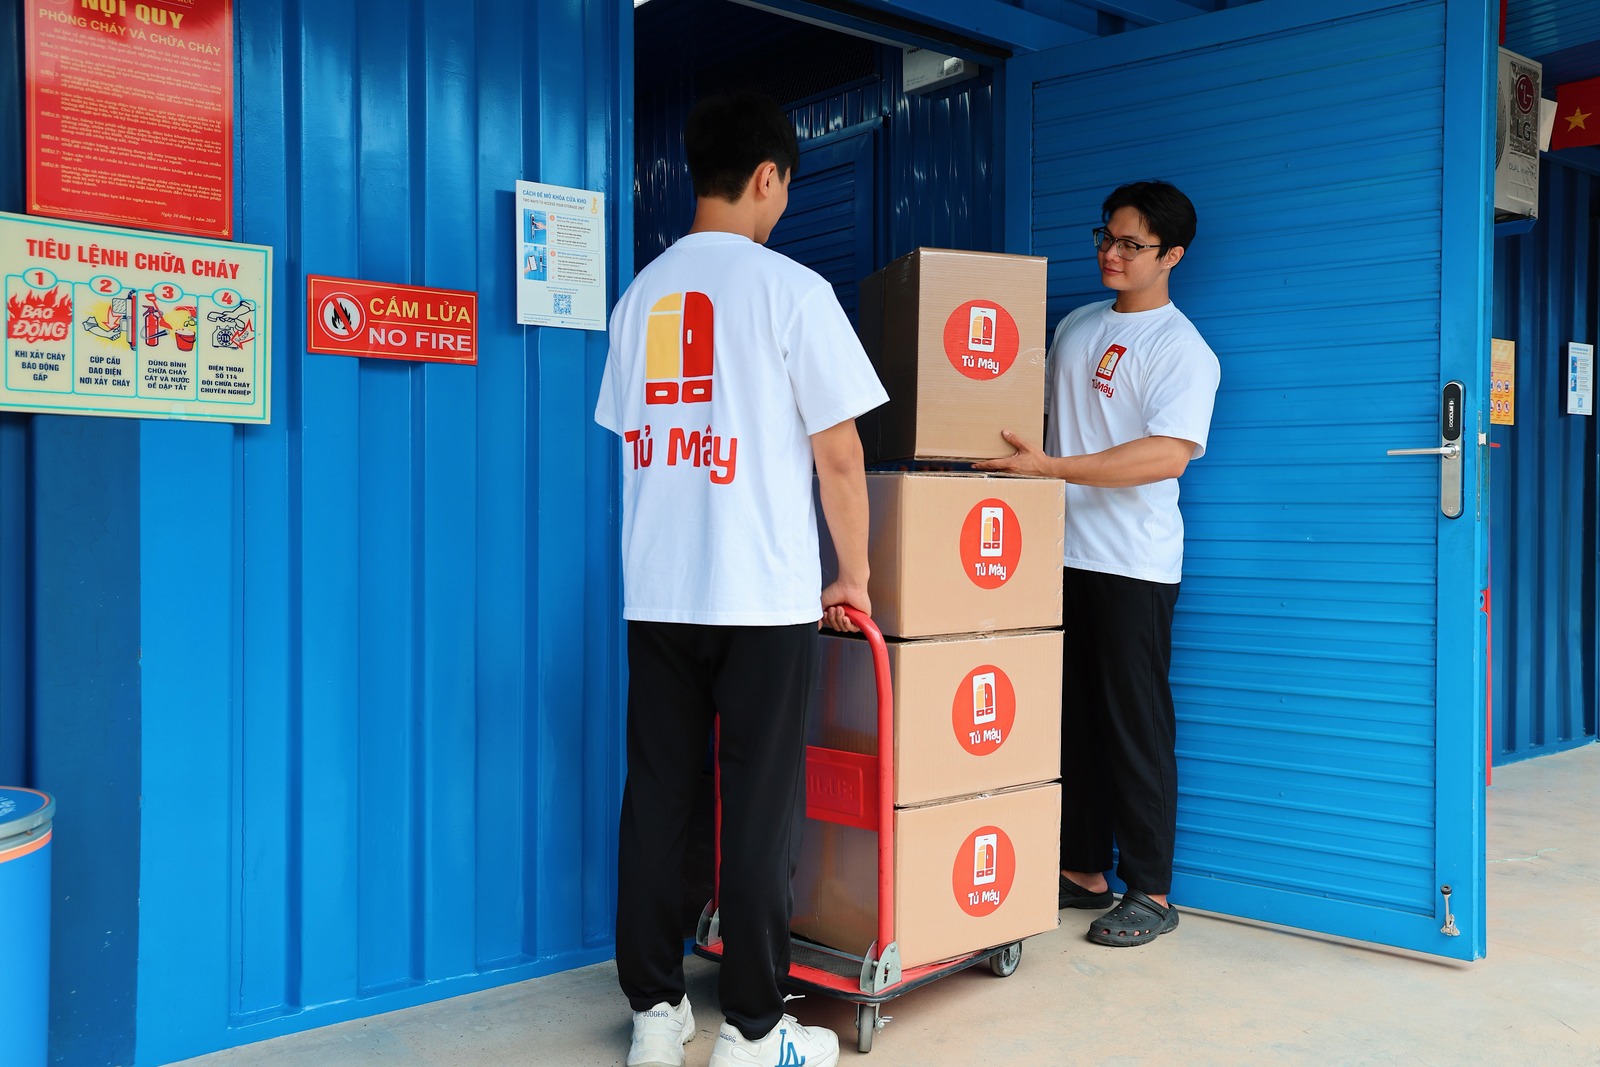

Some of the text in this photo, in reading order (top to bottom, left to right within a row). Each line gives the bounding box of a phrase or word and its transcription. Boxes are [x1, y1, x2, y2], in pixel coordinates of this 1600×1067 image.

[135, 4, 184, 30] QUY
[39, 9, 87, 28] PHÒNG
[91, 20, 126, 36] CHÁY
[130, 28, 146, 41] VÀ
[151, 32, 185, 49] CHỮA
[188, 39, 220, 56] CHÁY
[1516, 119, 1530, 141] LG
[26, 238, 239, 279] TIÊU LỆNH CHỮA CHÁY
[35, 272, 44, 285] 1
[100, 280, 112, 292] 2
[162, 286, 174, 298] 3
[222, 292, 233, 304] 4
[20, 304, 54, 319] BÁO
[369, 295, 471, 324] CẤM LỬA
[12, 320, 66, 341] ĐỘNG
[369, 327, 472, 352] NO FIRE
[15, 350, 27, 358] KHI
[47, 352, 66, 361] CHÁY
[22, 362, 59, 372] BÁO ĐỘNG
[105, 367, 121, 377] ĐIỆN
[962, 355, 999, 374] Tủ Mây
[112, 378, 130, 387] CHÁY
[624, 424, 738, 485] Tủ Mây
[983, 727, 1001, 744] Mây
[982, 889, 1000, 905] Mây
